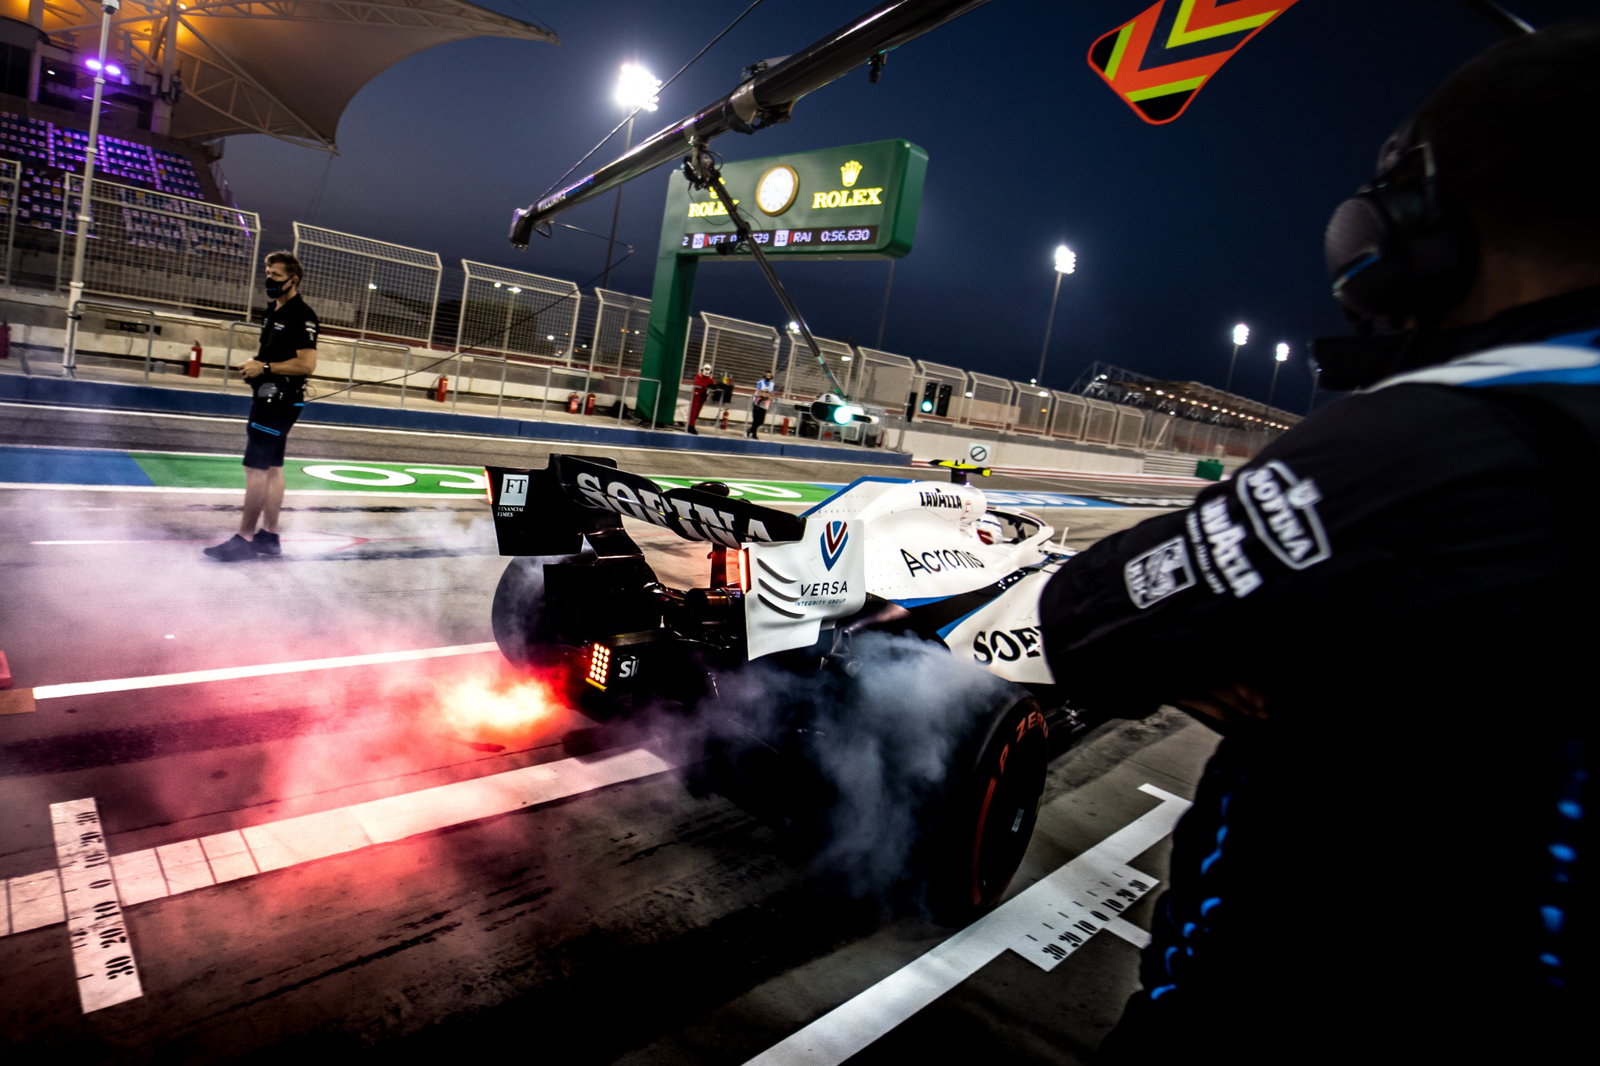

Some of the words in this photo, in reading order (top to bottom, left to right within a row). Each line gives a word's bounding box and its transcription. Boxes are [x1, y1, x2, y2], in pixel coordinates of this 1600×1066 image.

[811, 187, 883, 209] ROLEX
[688, 200, 740, 217] ROLE
[792, 231, 813, 243] RAI
[820, 228, 871, 242] 0:56.630
[504, 478, 527, 494] FT
[919, 487, 963, 509] LAVAZZA
[576, 472, 773, 550] SOFINA
[1246, 467, 1313, 561] SOFINA
[1200, 495, 1263, 598] LAVAZZA
[900, 548, 985, 577] Acronis
[800, 580, 848, 597] VERSA
[973, 625, 1041, 665] SOF
[1100, 898, 1125, 913] 10
[1090, 910, 1111, 922] 0
[1073, 919, 1099, 936] 10
[1058, 931, 1084, 948] 20
[1041, 943, 1069, 961] 30
